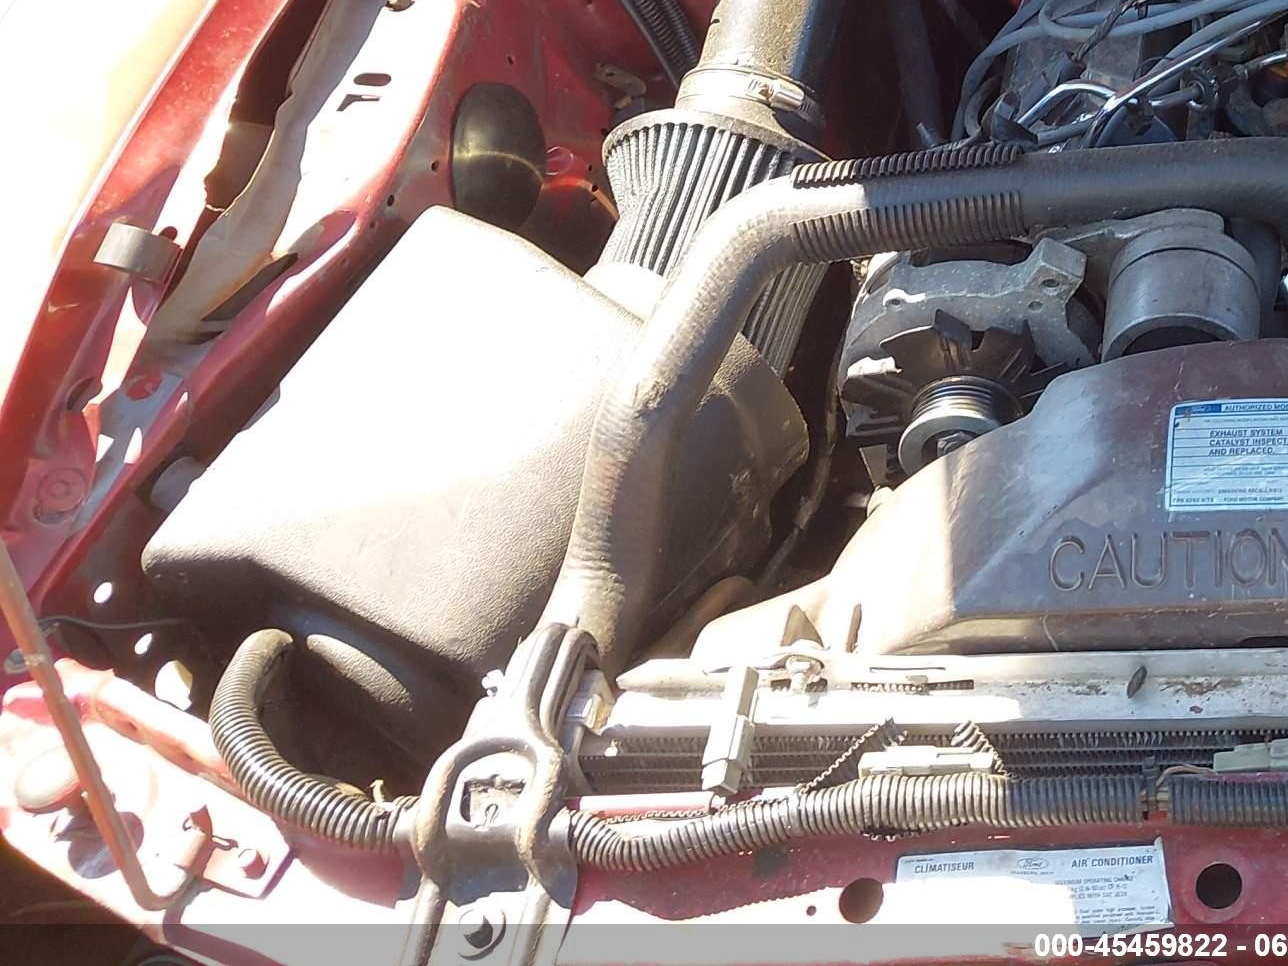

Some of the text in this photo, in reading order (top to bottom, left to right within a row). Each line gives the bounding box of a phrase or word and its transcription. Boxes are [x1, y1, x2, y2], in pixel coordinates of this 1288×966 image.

[1224, 403, 1274, 412] AUTHORIZED
[1210, 429, 1247, 437] EXHAUST
[1209, 439, 1249, 447] CATALYST
[1208, 448, 1227, 456] AND
[1022, 858, 1042, 869] Ford
[1071, 855, 1154, 868] AIR CONDITIONER
[914, 861, 975, 875] CLIMATISEUR
